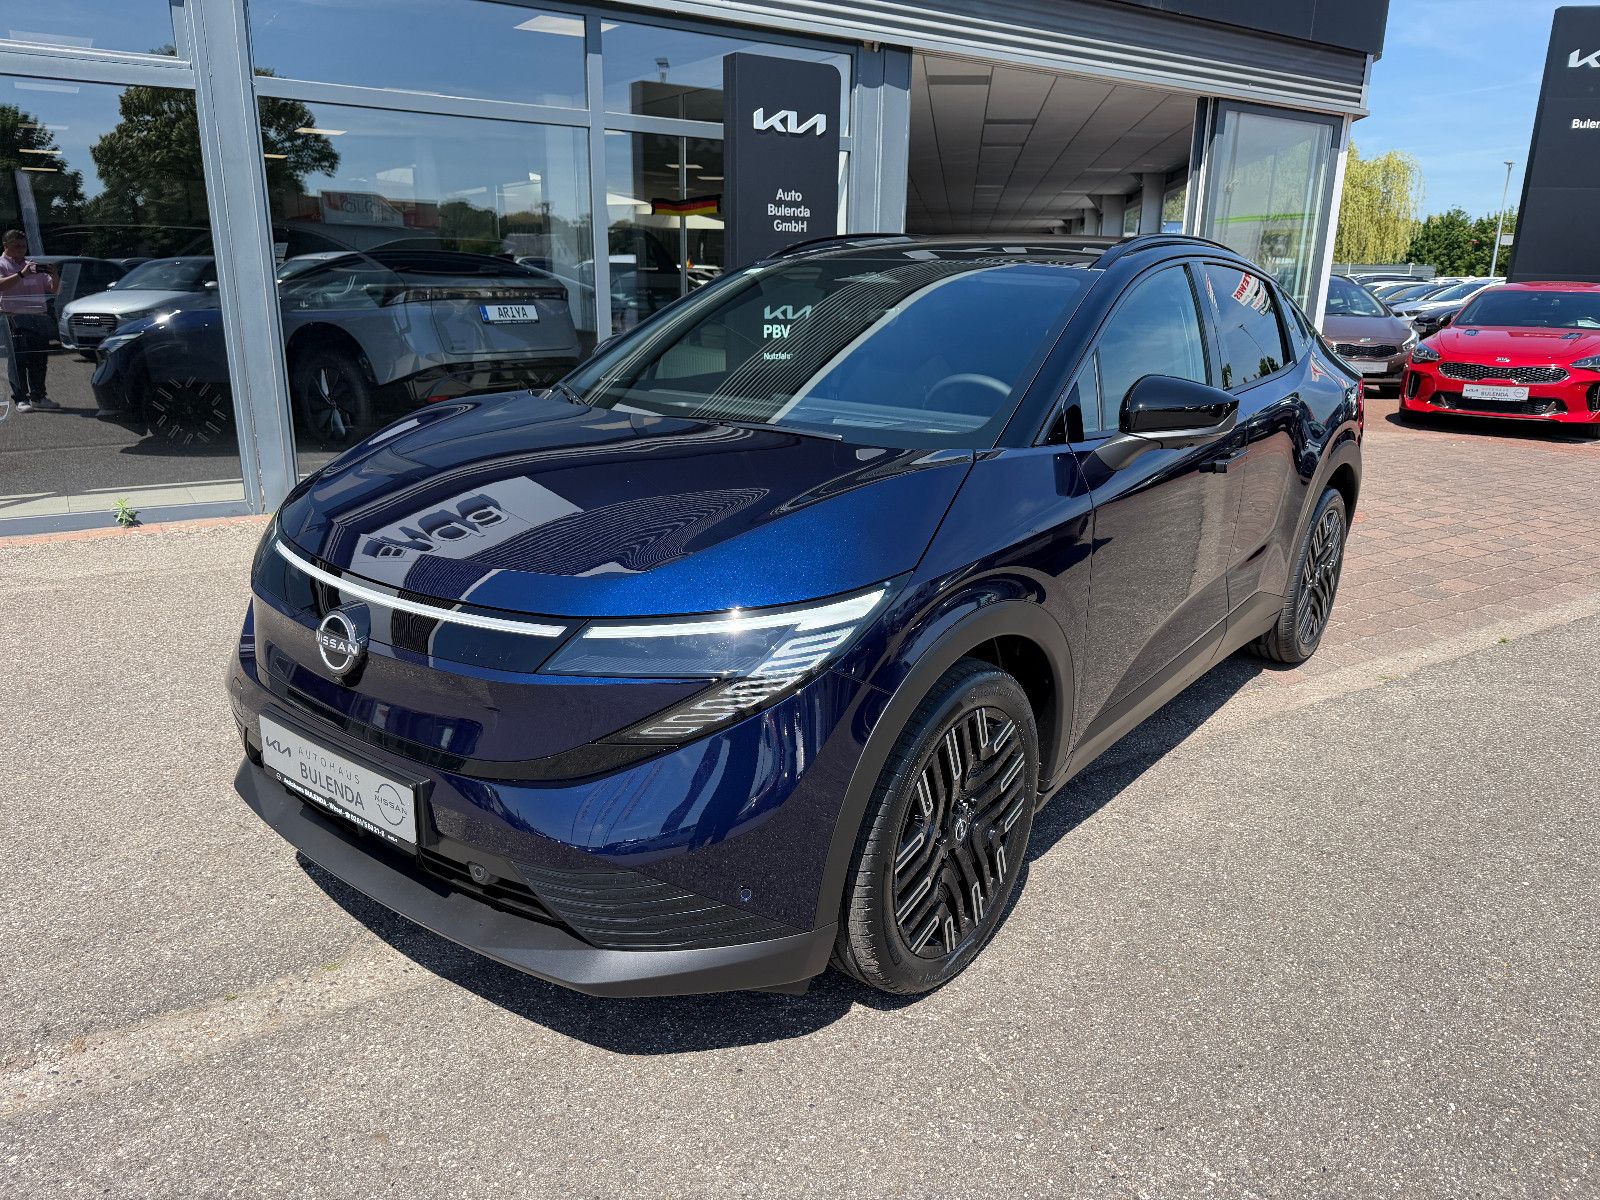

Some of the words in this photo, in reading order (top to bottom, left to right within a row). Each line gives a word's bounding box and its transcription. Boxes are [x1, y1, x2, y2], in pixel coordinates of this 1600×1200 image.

[753, 107, 827, 136] KIA
[776, 188, 803, 202] Auto
[767, 203, 811, 218] Bulenda
[773, 219, 808, 233] GmbH
[497, 306, 529, 319] ARIYA
[763, 324, 791, 339] PBV
[316, 629, 358, 655] NISSAN
[265, 736, 291, 757] KIA
[299, 747, 360, 785] AUTOHAUS
[300, 761, 365, 811] BULENDA
